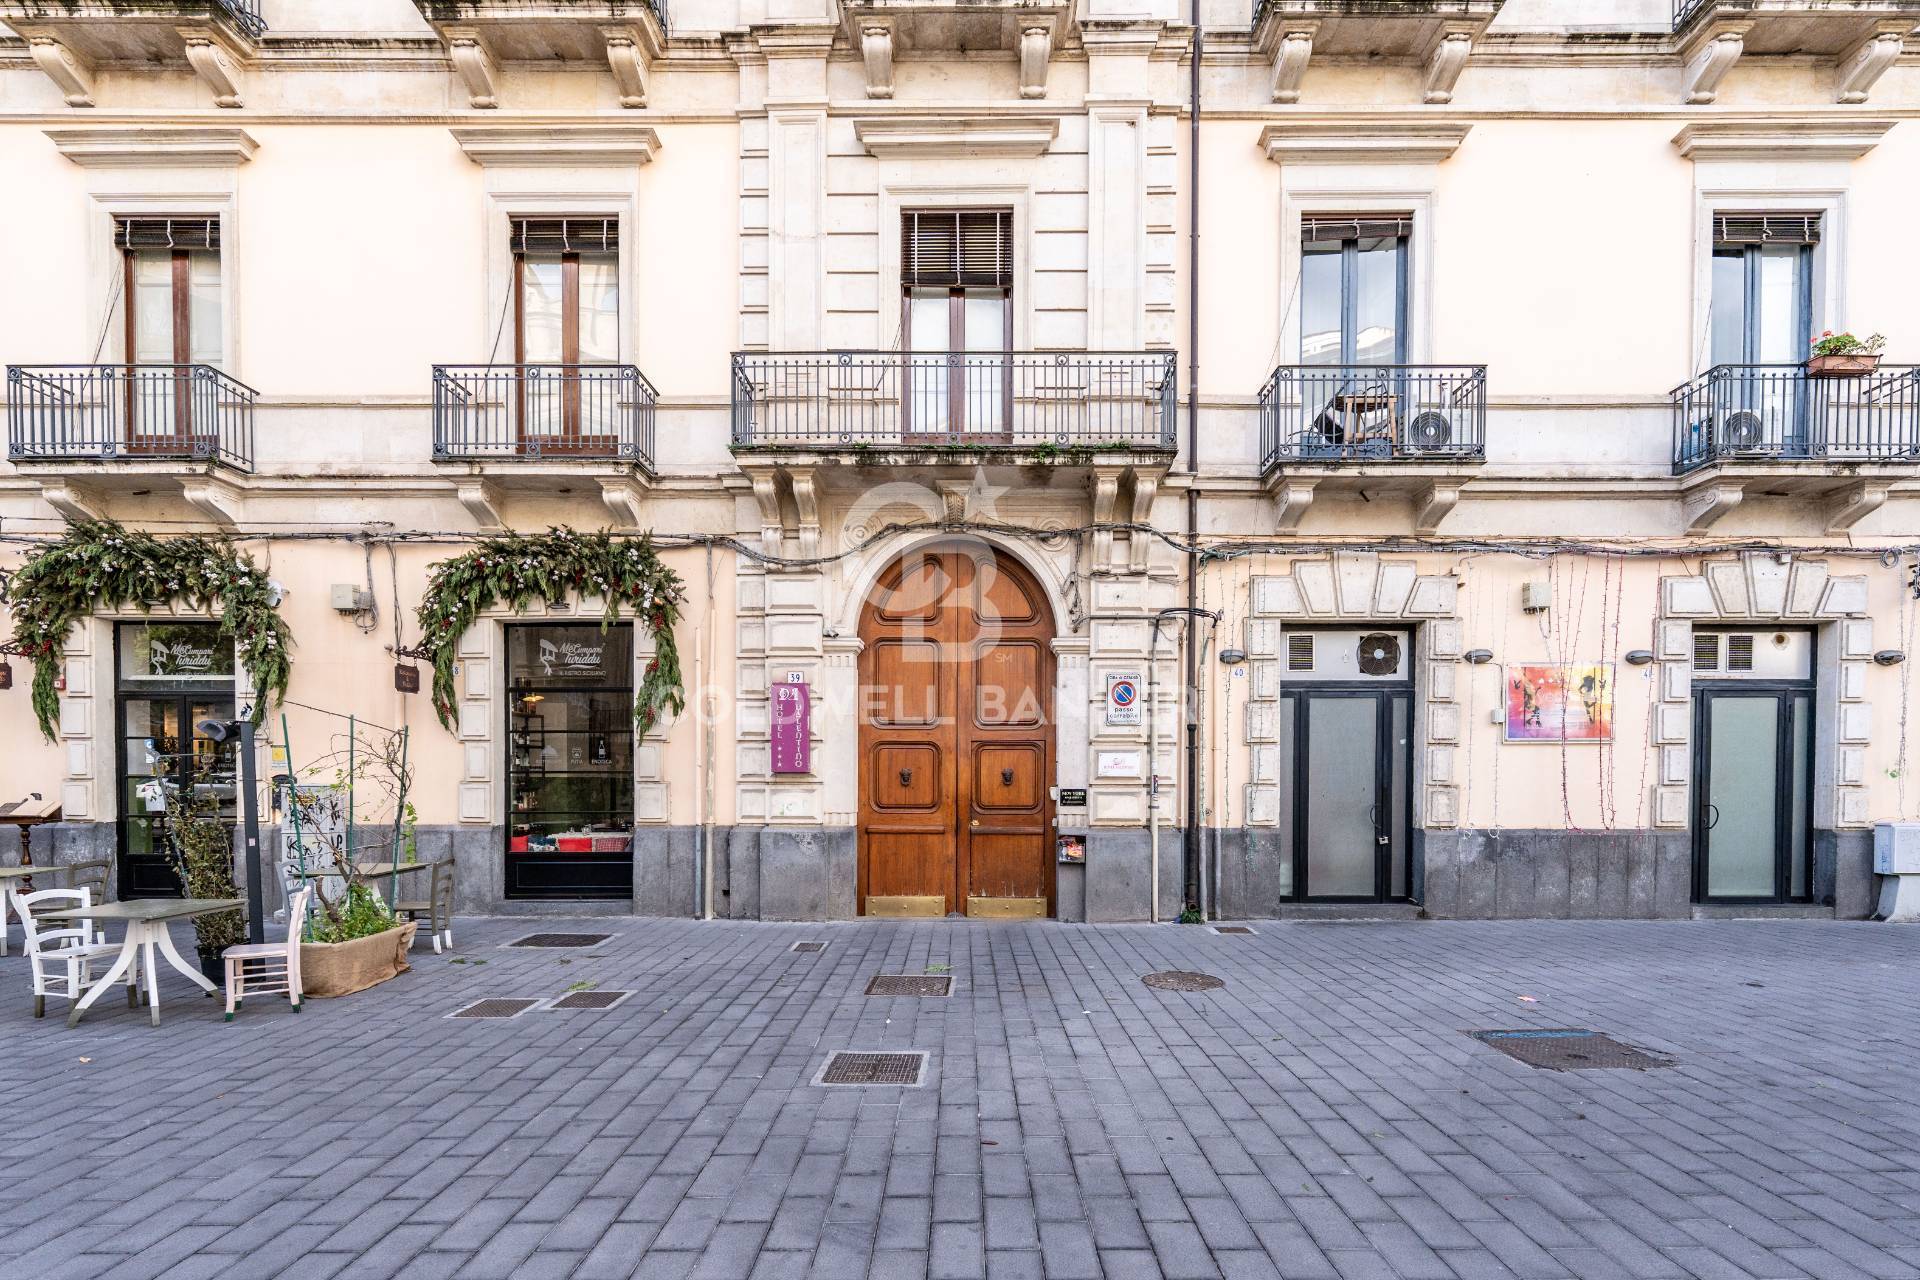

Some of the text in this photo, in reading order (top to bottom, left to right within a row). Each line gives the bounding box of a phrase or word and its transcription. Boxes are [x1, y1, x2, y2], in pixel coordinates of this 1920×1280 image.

[176, 654, 212, 666] Turiddu
[564, 652, 601, 664] Turiddu
[791, 673, 801, 683] 39
